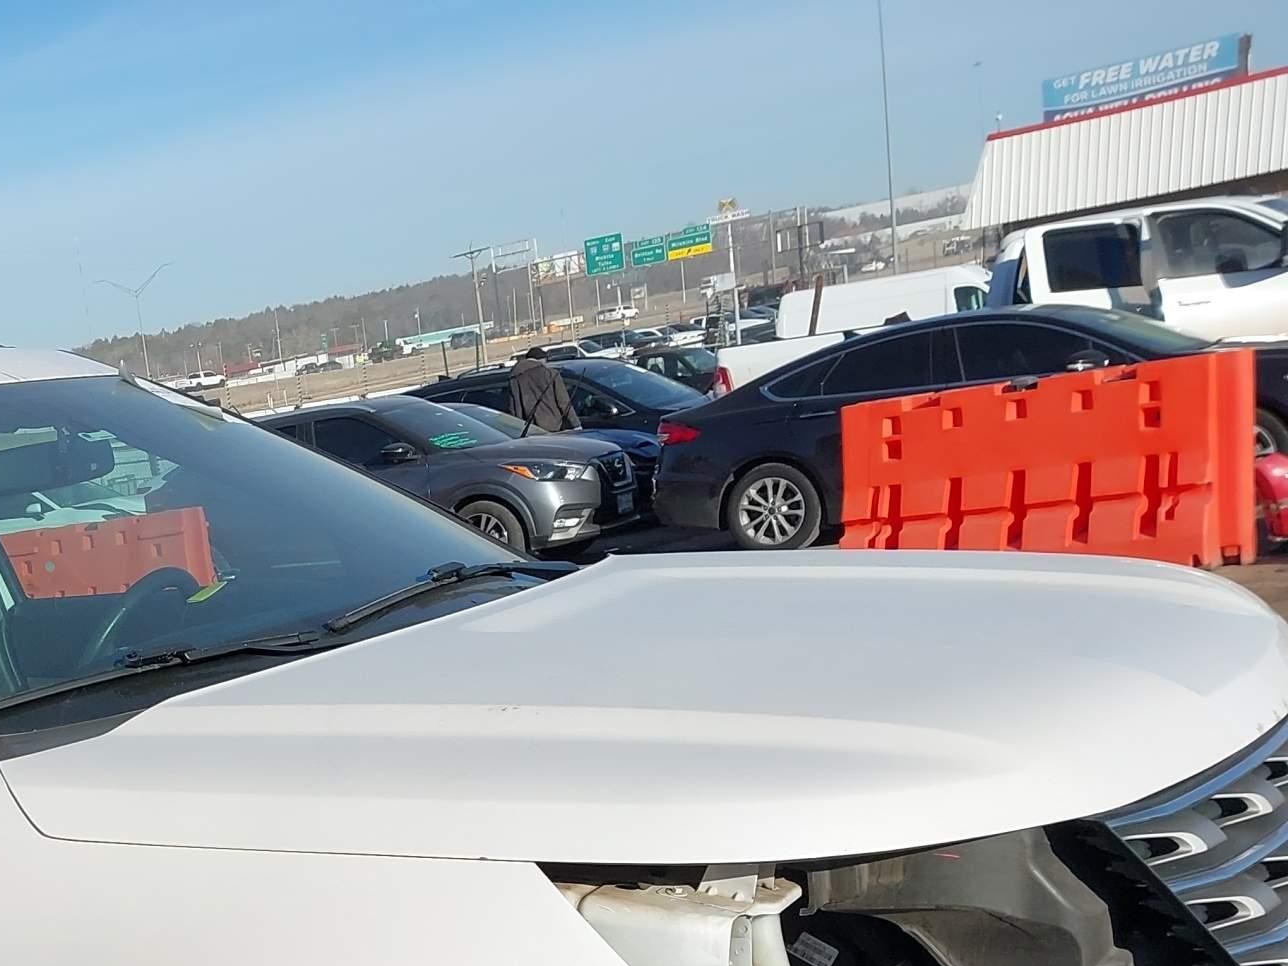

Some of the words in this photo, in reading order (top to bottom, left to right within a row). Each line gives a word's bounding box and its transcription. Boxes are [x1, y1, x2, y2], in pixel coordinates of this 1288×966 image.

[1053, 76, 1076, 90] GET
[1078, 61, 1134, 89] FREE
[1138, 41, 1220, 76] WATER
[1063, 90, 1088, 105] FOR
[1091, 82, 1129, 101] LAWN
[1130, 62, 1209, 90] IRRIGATION
